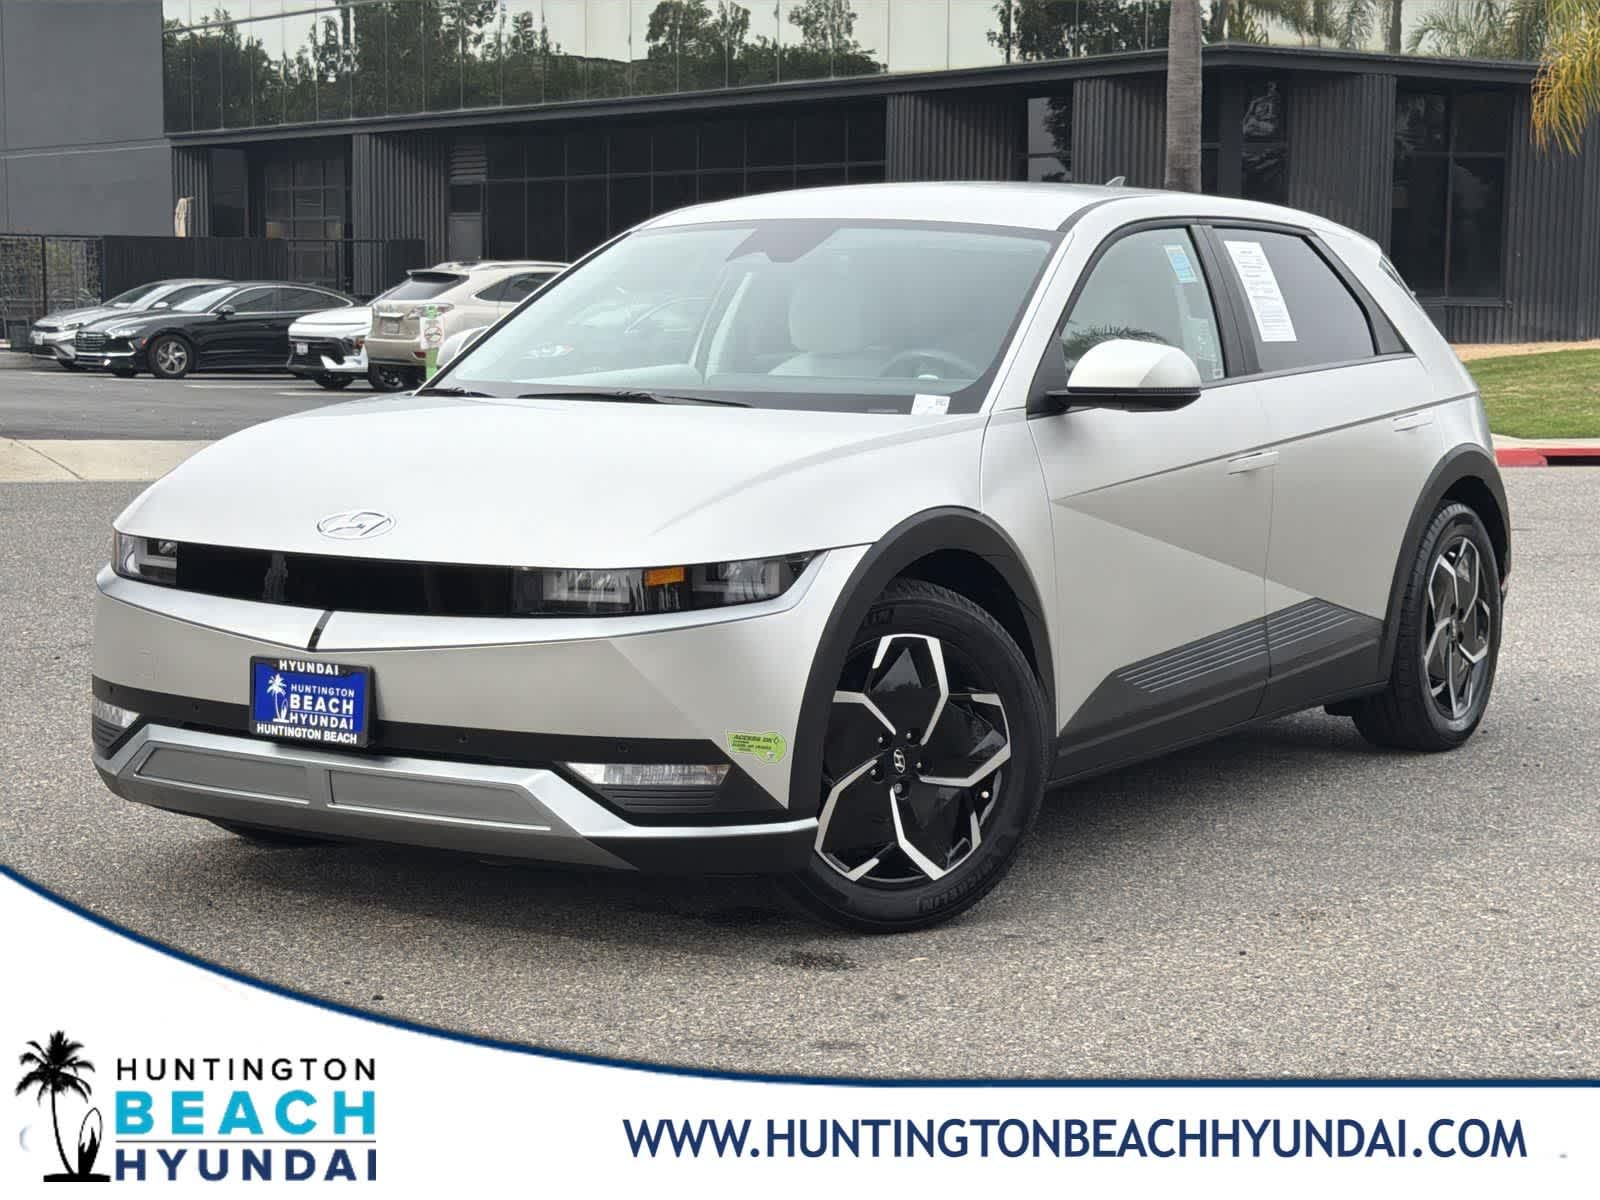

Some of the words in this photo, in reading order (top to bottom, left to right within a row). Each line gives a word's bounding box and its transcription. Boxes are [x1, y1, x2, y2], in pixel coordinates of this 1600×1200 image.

[280, 660, 339, 676] HYUNDAI
[290, 683, 355, 698] HUNTINGTON
[290, 693, 355, 715] BEACH
[289, 712, 354, 730] HYUNDAI
[256, 723, 322, 741] HUNTINGTON
[323, 730, 358, 744] BEACH
